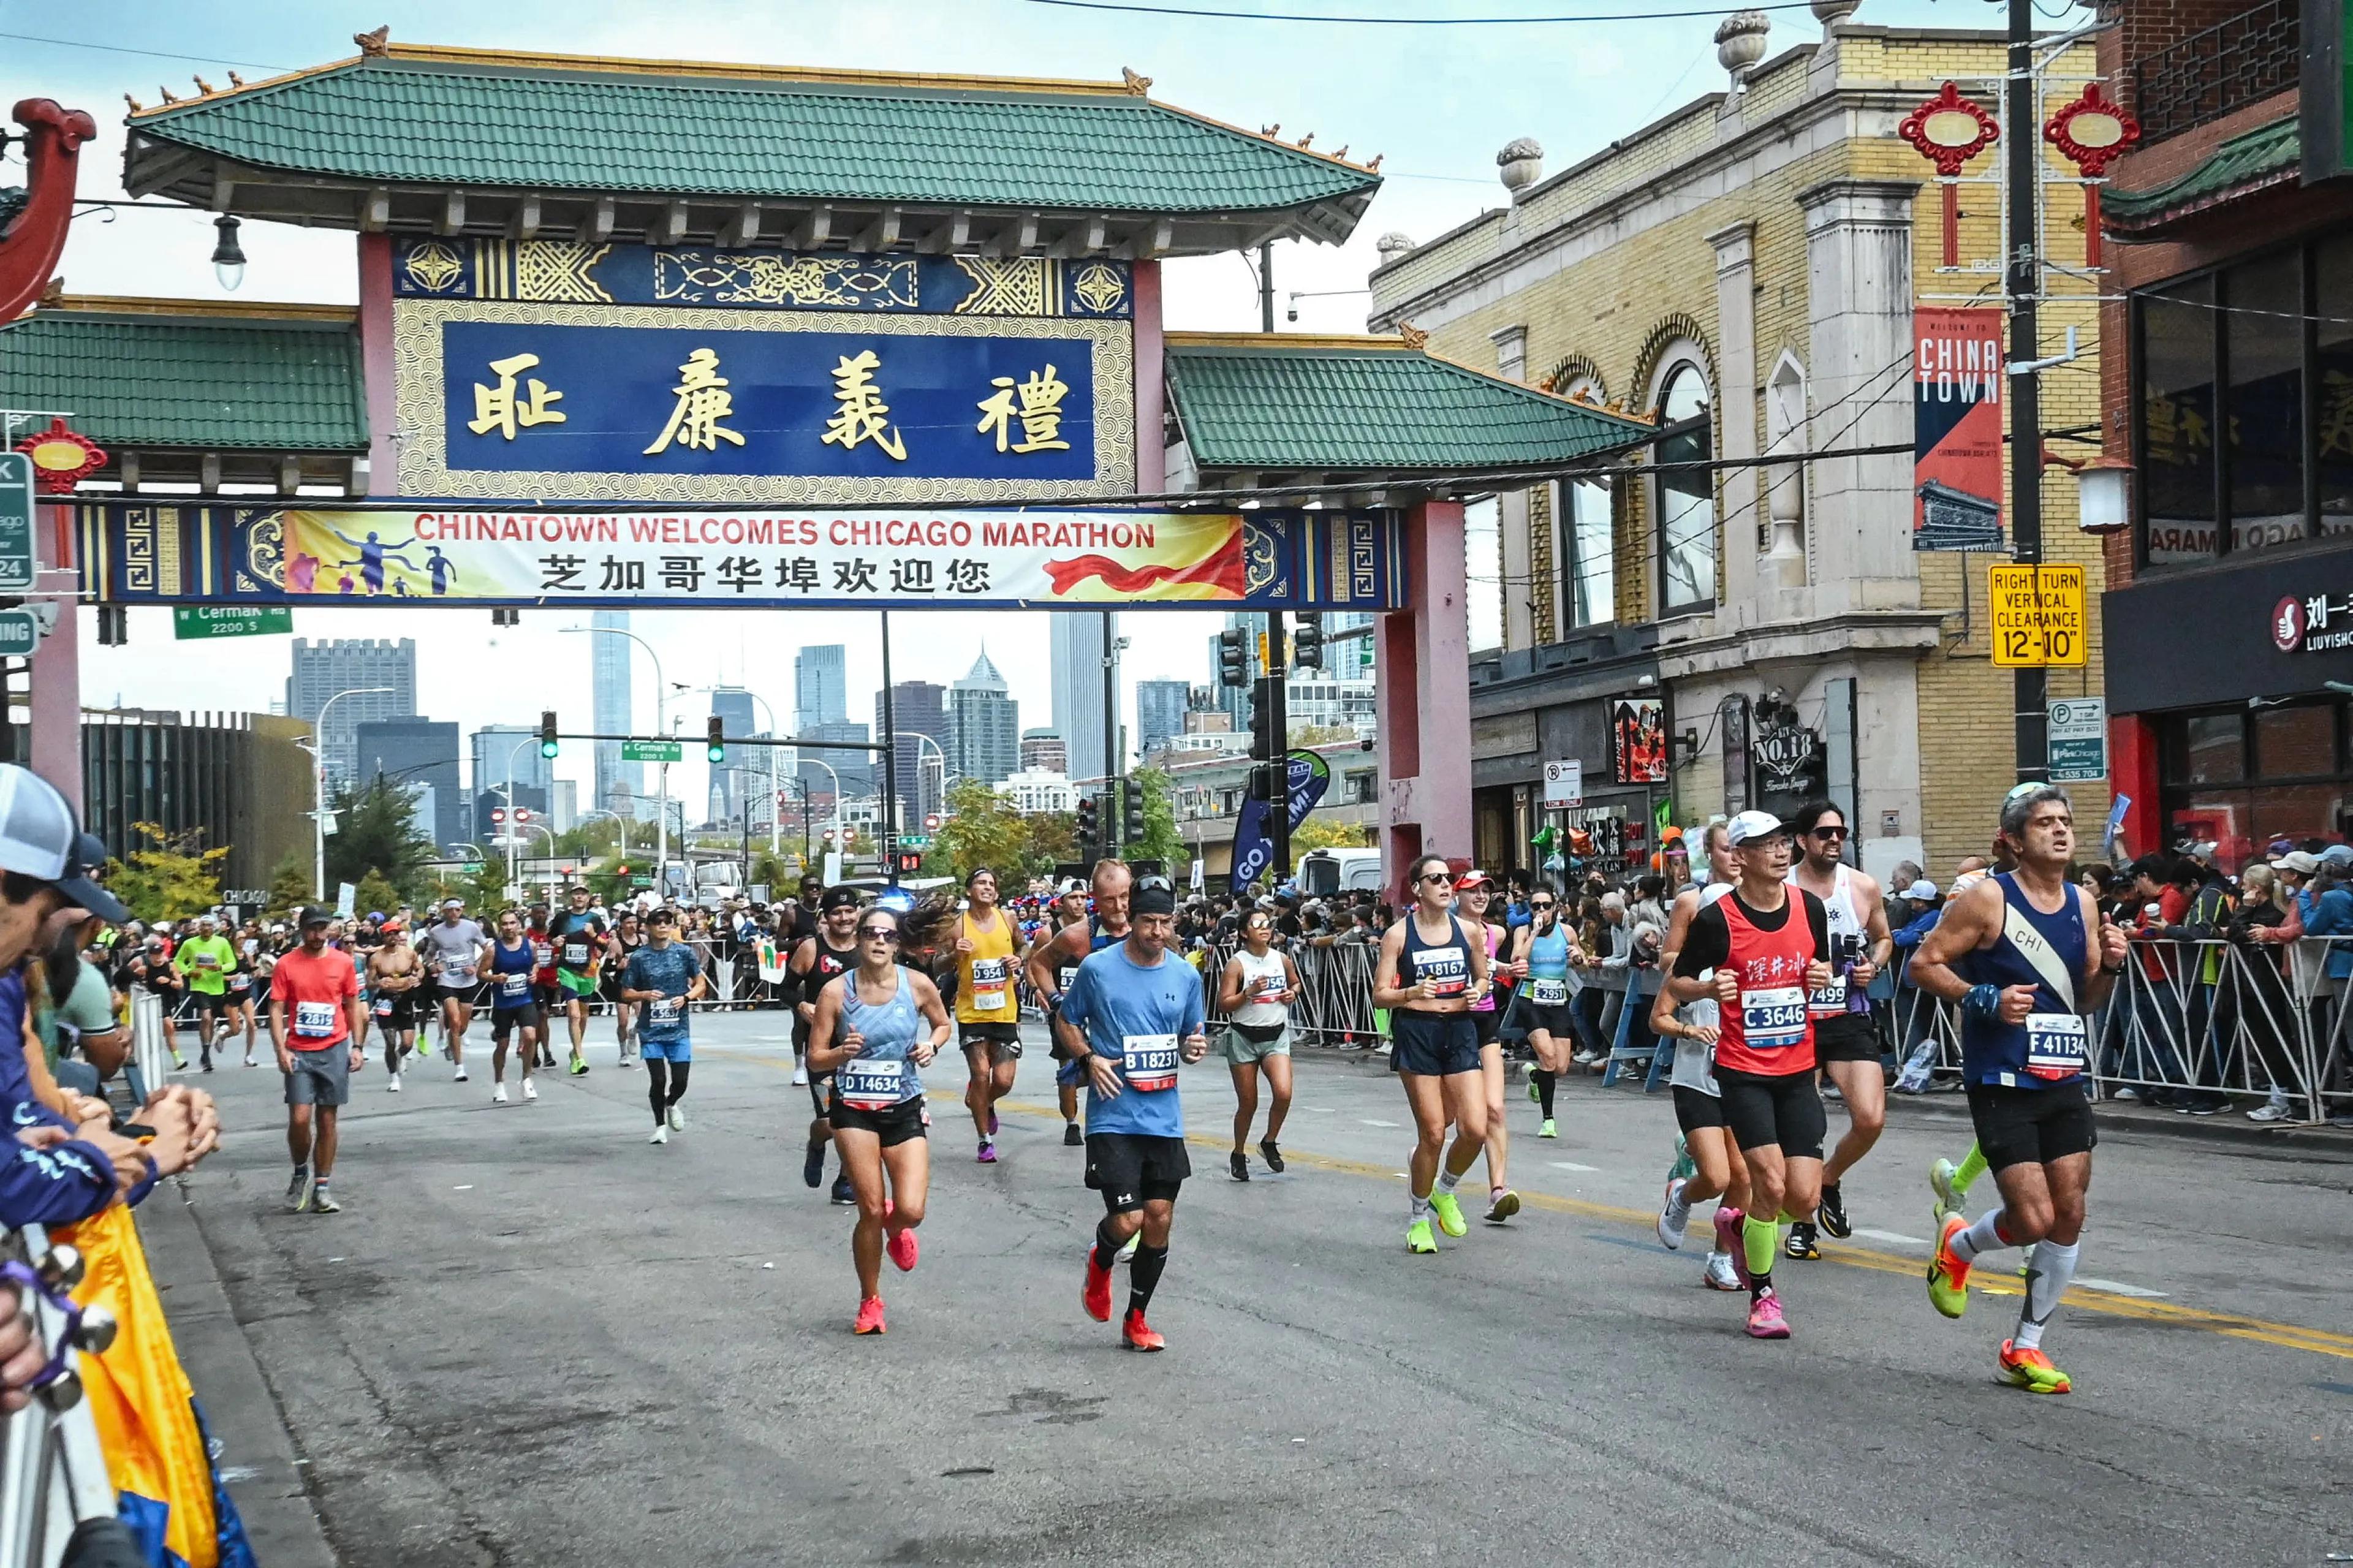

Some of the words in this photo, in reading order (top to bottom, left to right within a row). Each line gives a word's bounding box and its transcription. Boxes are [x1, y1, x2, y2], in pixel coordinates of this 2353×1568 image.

[1920, 338, 1997, 371] CHINA
[1919, 371, 1998, 404] TOWN
[414, 513, 618, 542] CHINATOWN
[629, 517, 819, 545] WELCOMES
[828, 519, 972, 547] CHICAGO
[982, 521, 1155, 548] MARATHON
[538, 553, 990, 594] 芝加哥华埠欢迎您
[1995, 574, 2036, 589] RIGHT
[2042, 574, 2078, 589] TURN
[2005, 593, 2070, 608] VERTICAL
[211, 622, 244, 634] 2200
[249, 621, 259, 631] S
[1998, 612, 2078, 627] CLEARANCE
[634, 743, 667, 752] Cermak
[1753, 734, 1812, 764] NO.18
[1237, 849, 1264, 881] GO
[223, 889, 267, 904] CHICAGO
[2014, 930, 2043, 952] CHI
[973, 969, 980, 979] D
[983, 966, 1005, 979] 9541
[1416, 964, 1425, 977] A
[1427, 961, 1465, 976] 18167
[1534, 988, 1540, 998] E
[1542, 988, 1563, 999] 2951
[651, 1010, 657, 1018] C
[660, 1009, 680, 1018] 5637
[1745, 1009, 1757, 1027] C
[1762, 1005, 1805, 1026] 3646
[2031, 1034, 2040, 1053] F
[2044, 1034, 2084, 1055] 41134
[1126, 1053, 1137, 1069] B
[1140, 1050, 1178, 1069] 18231
[846, 1076, 854, 1090] D
[858, 1077, 900, 1092] 14634
